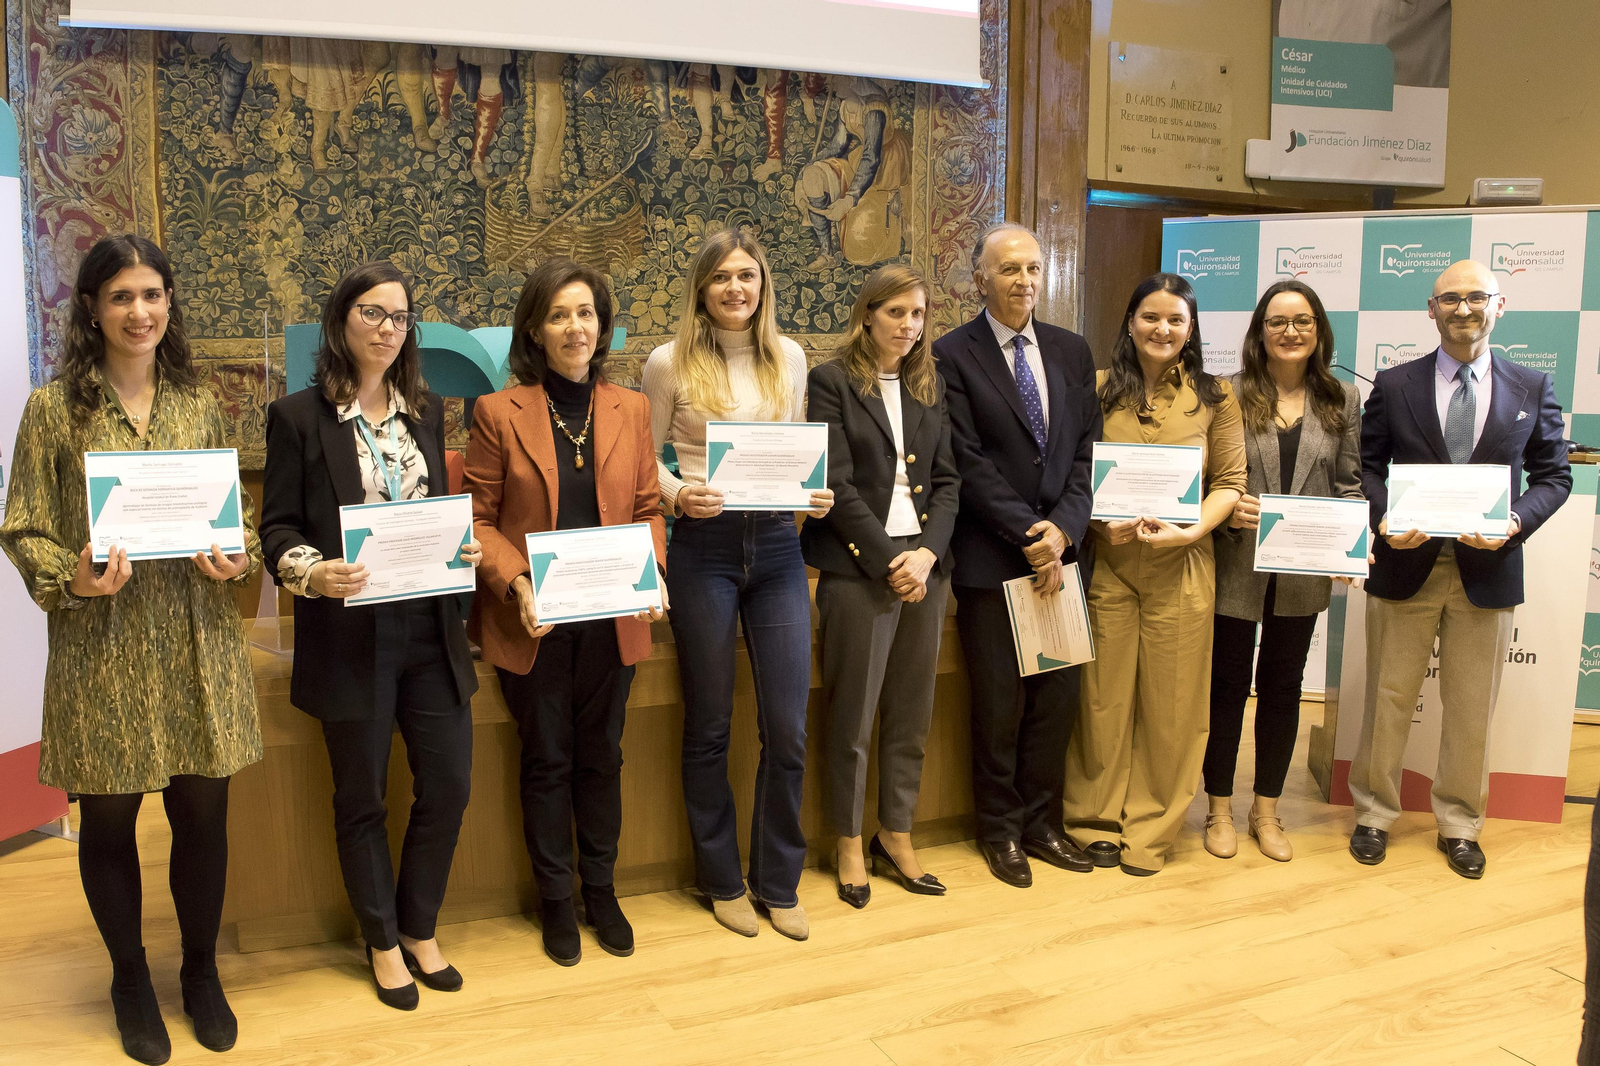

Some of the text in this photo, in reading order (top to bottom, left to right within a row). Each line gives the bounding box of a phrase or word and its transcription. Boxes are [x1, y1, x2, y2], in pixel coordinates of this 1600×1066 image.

[1281, 48, 1313, 62] César
[1281, 65, 1306, 74] Médico
[1171, 80, 1176, 90] A
[1281, 78, 1304, 86] Unidad
[1316, 80, 1348, 89] Cuidados
[1280, 87, 1332, 98] Intensivos (UCI)
[1135, 94, 1166, 108] CARLOS
[1169, 98, 1202, 112] JIMENEZ
[1204, 102, 1222, 113] DIAZ
[1309, 134, 1431, 151] Fundación Jiménez Díaz
